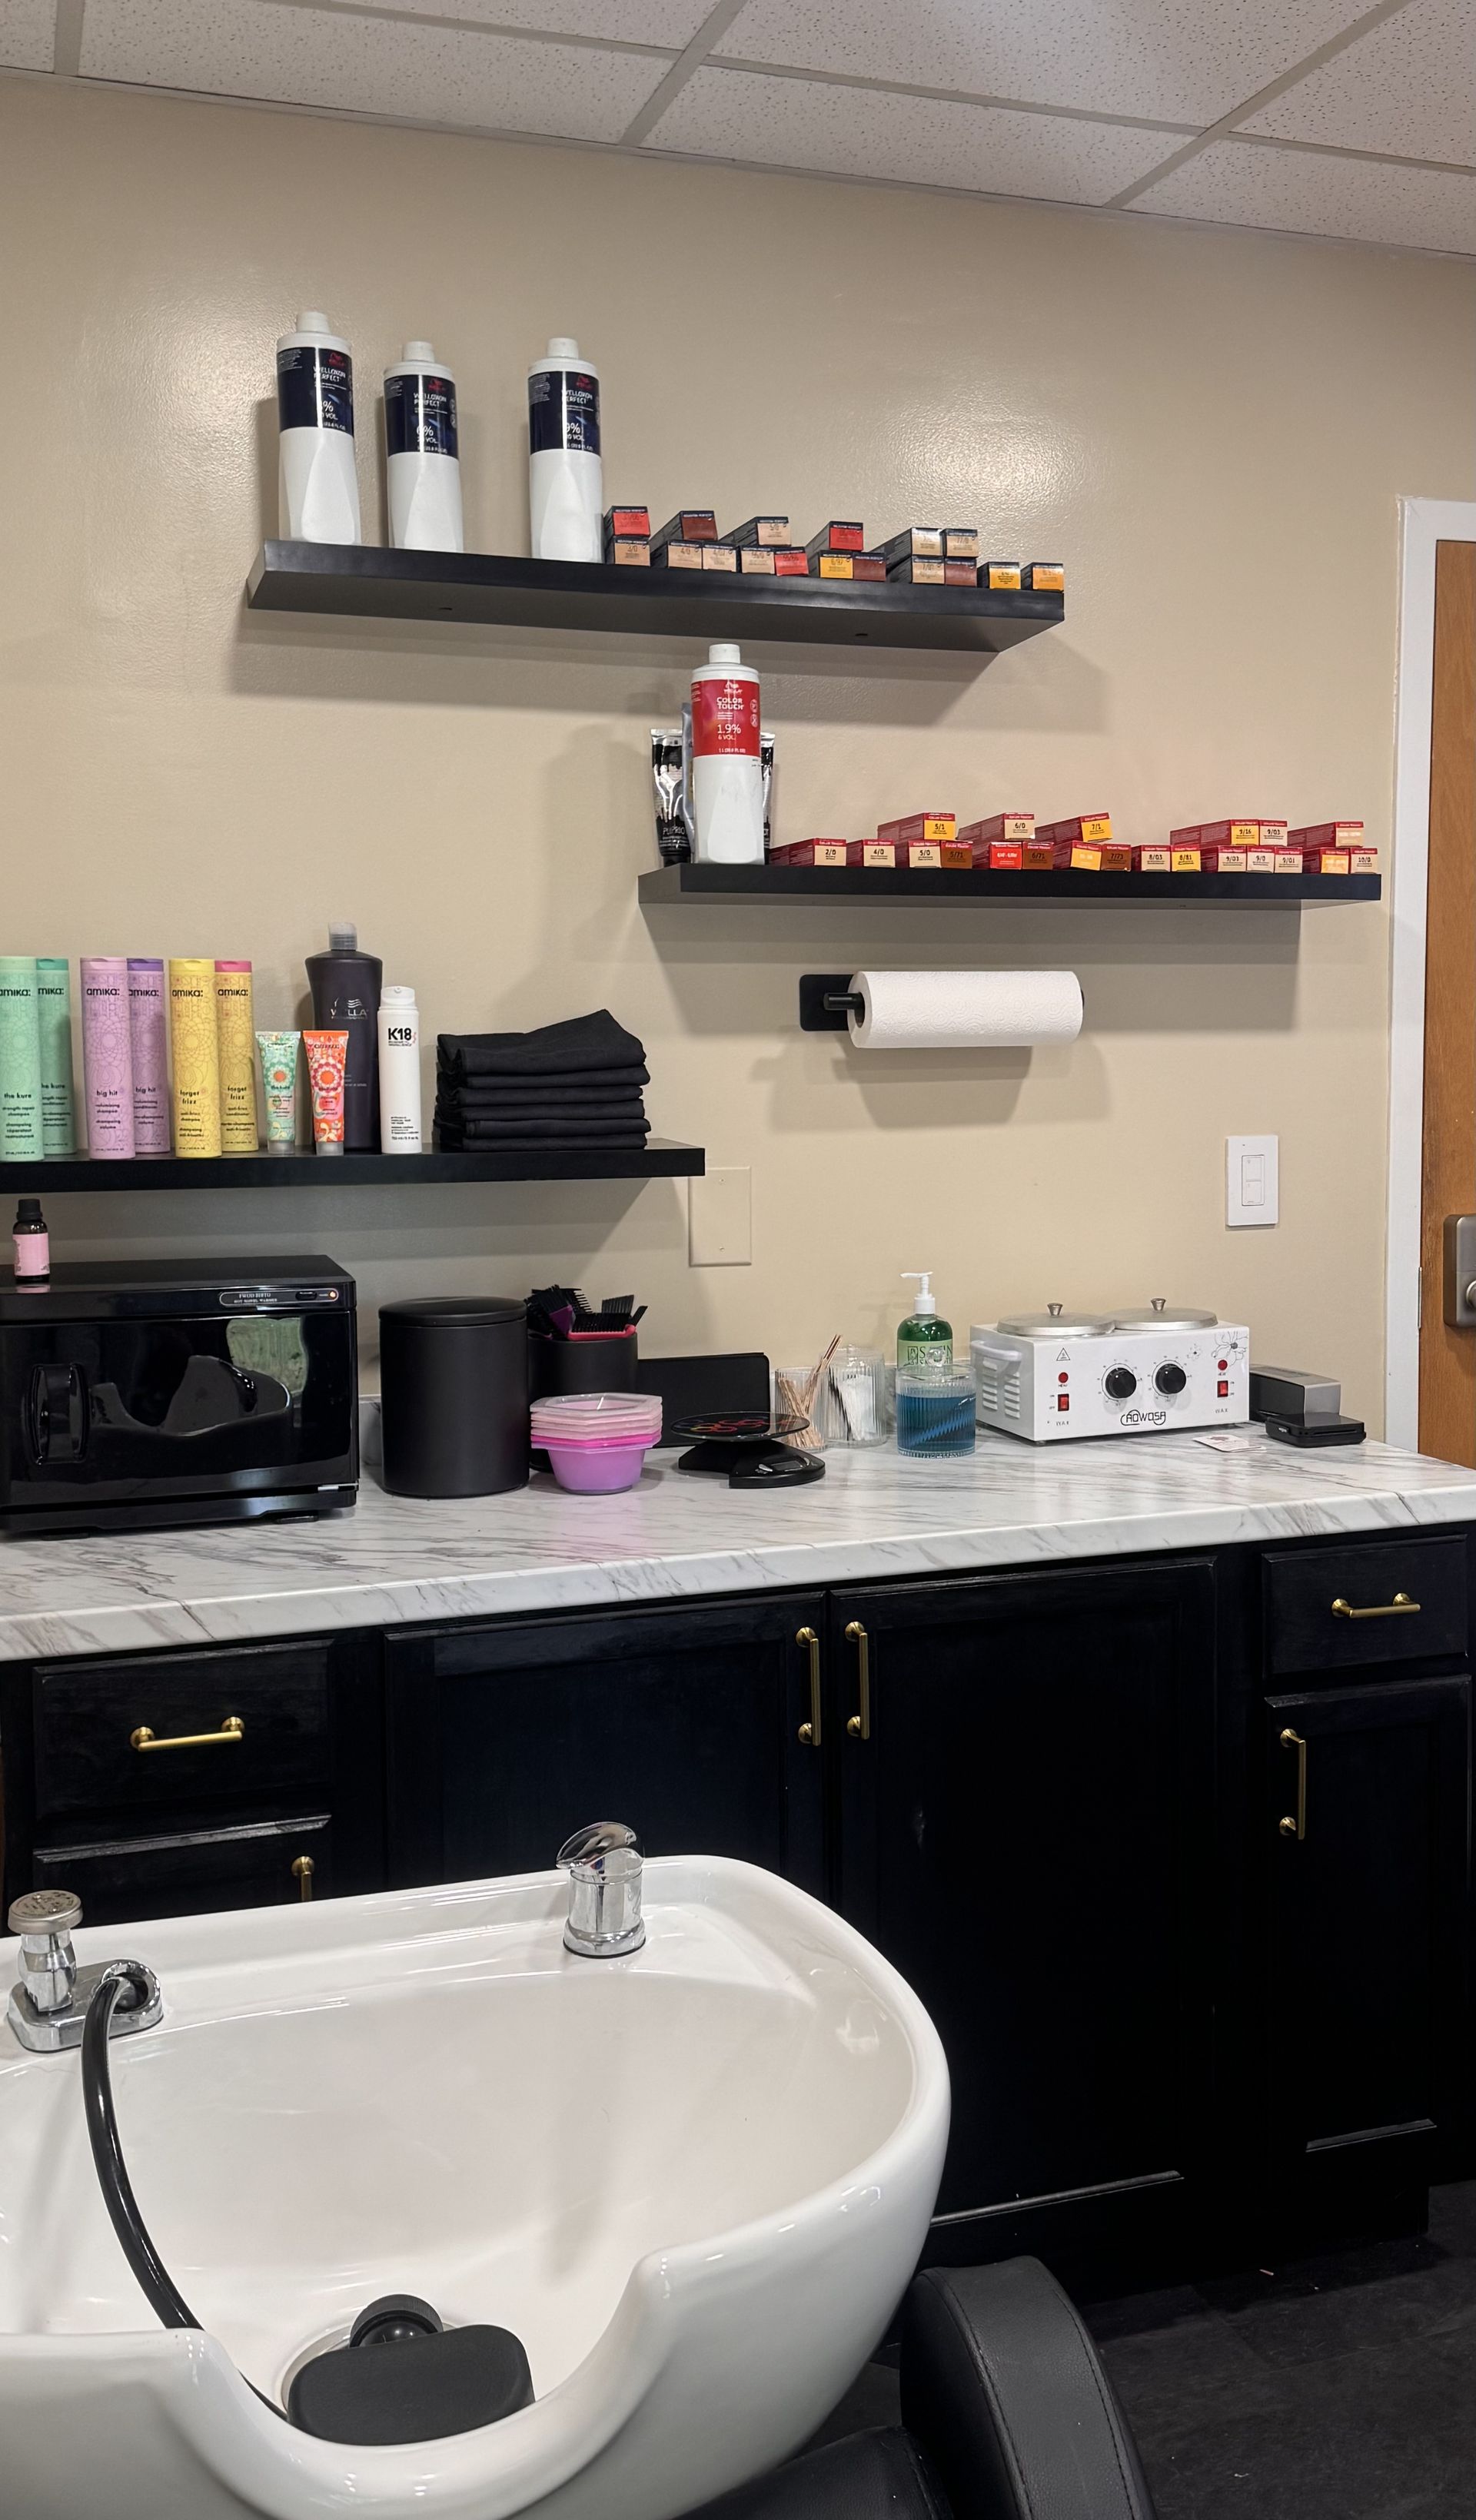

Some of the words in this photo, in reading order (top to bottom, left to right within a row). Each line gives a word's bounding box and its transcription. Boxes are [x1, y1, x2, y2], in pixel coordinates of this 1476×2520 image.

[717, 724, 741, 735] 1.9%
[172, 988, 204, 998] amika:
[218, 988, 248, 997] amika:
[387, 1028, 412, 1041] K18
[96, 1089, 107, 1097] big
[135, 1086, 146, 1094] big
[180, 1089, 199, 1097] forget
